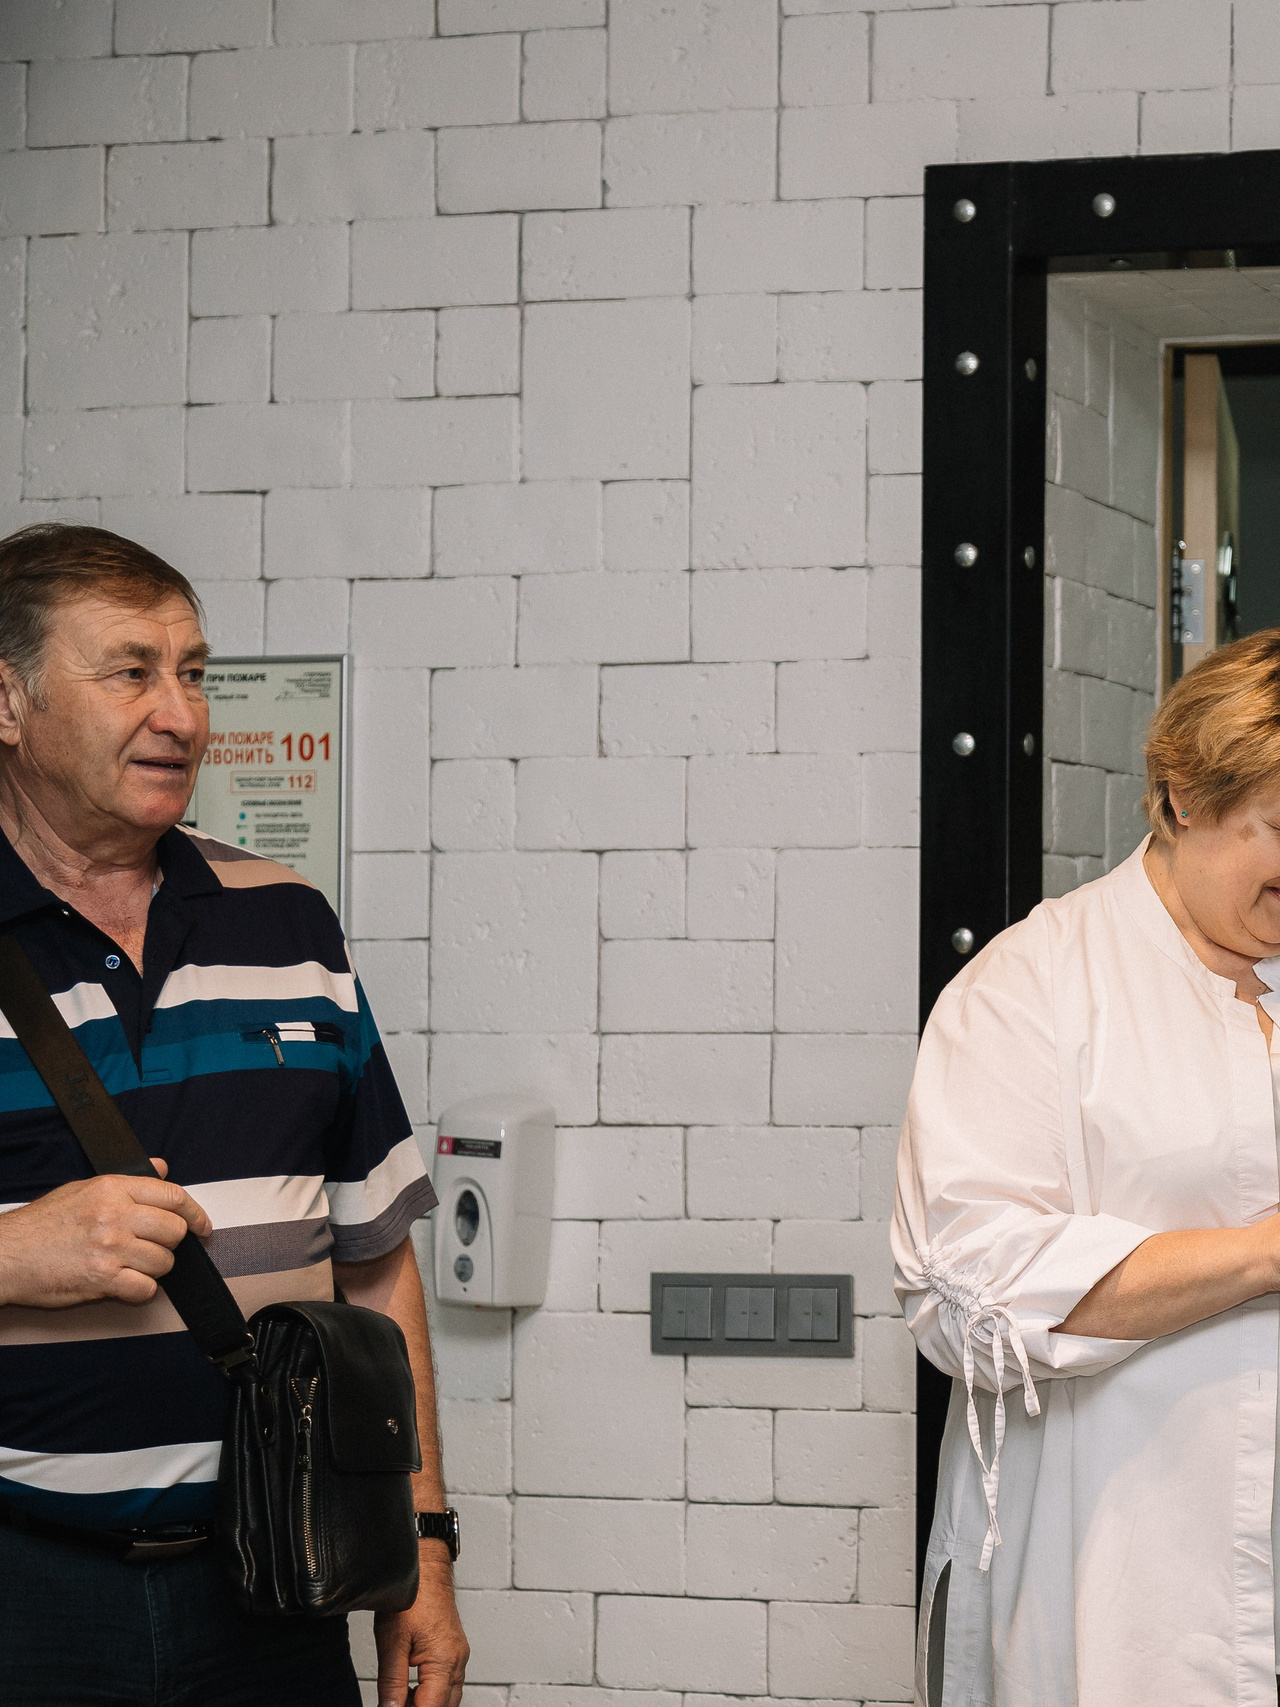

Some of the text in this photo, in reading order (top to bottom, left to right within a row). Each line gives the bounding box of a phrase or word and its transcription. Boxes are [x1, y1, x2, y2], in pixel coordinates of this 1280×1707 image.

[206, 673, 225, 682] ПРИ
[227, 672, 267, 682] ПОЖАРЕ
[209, 731, 274, 745] РИ ПОЖАРЕ
[280, 732, 331, 762] 101
[203, 748, 275, 765] ЗВОНИТЬ
[287, 774, 313, 789] 112
